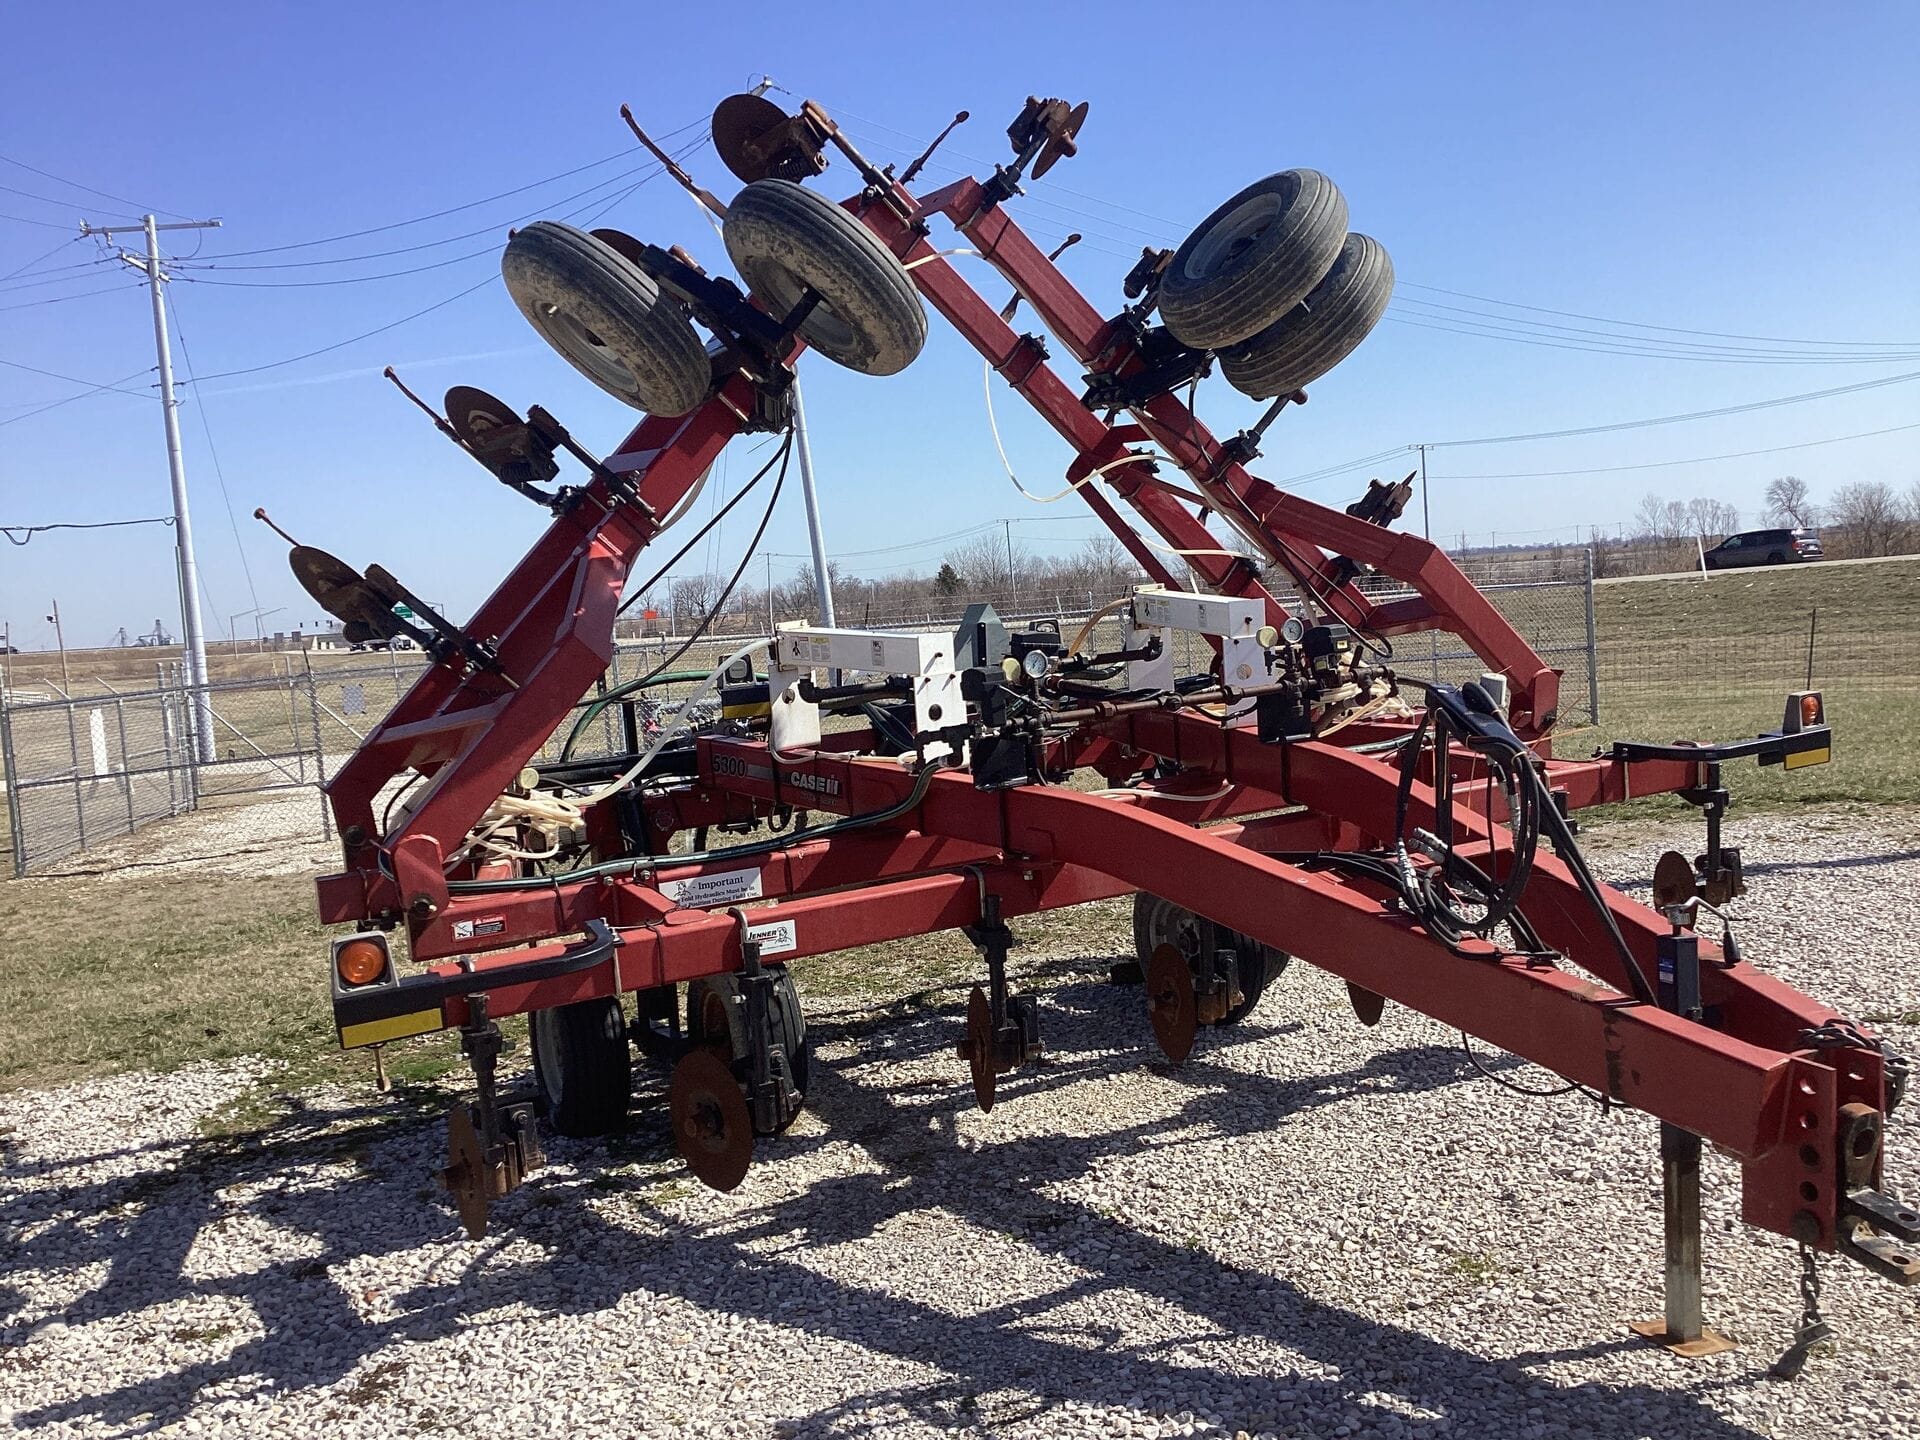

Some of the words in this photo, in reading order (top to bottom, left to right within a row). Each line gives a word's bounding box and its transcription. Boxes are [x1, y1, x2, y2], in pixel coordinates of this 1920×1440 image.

[712, 754, 747, 778] 5300
[790, 771, 826, 792] CASE
[698, 876, 744, 890] Important
[694, 891, 726, 901] Hydraulics
[712, 895, 732, 904] During
[732, 892, 746, 900] Field
[748, 930, 777, 940] JENNER
